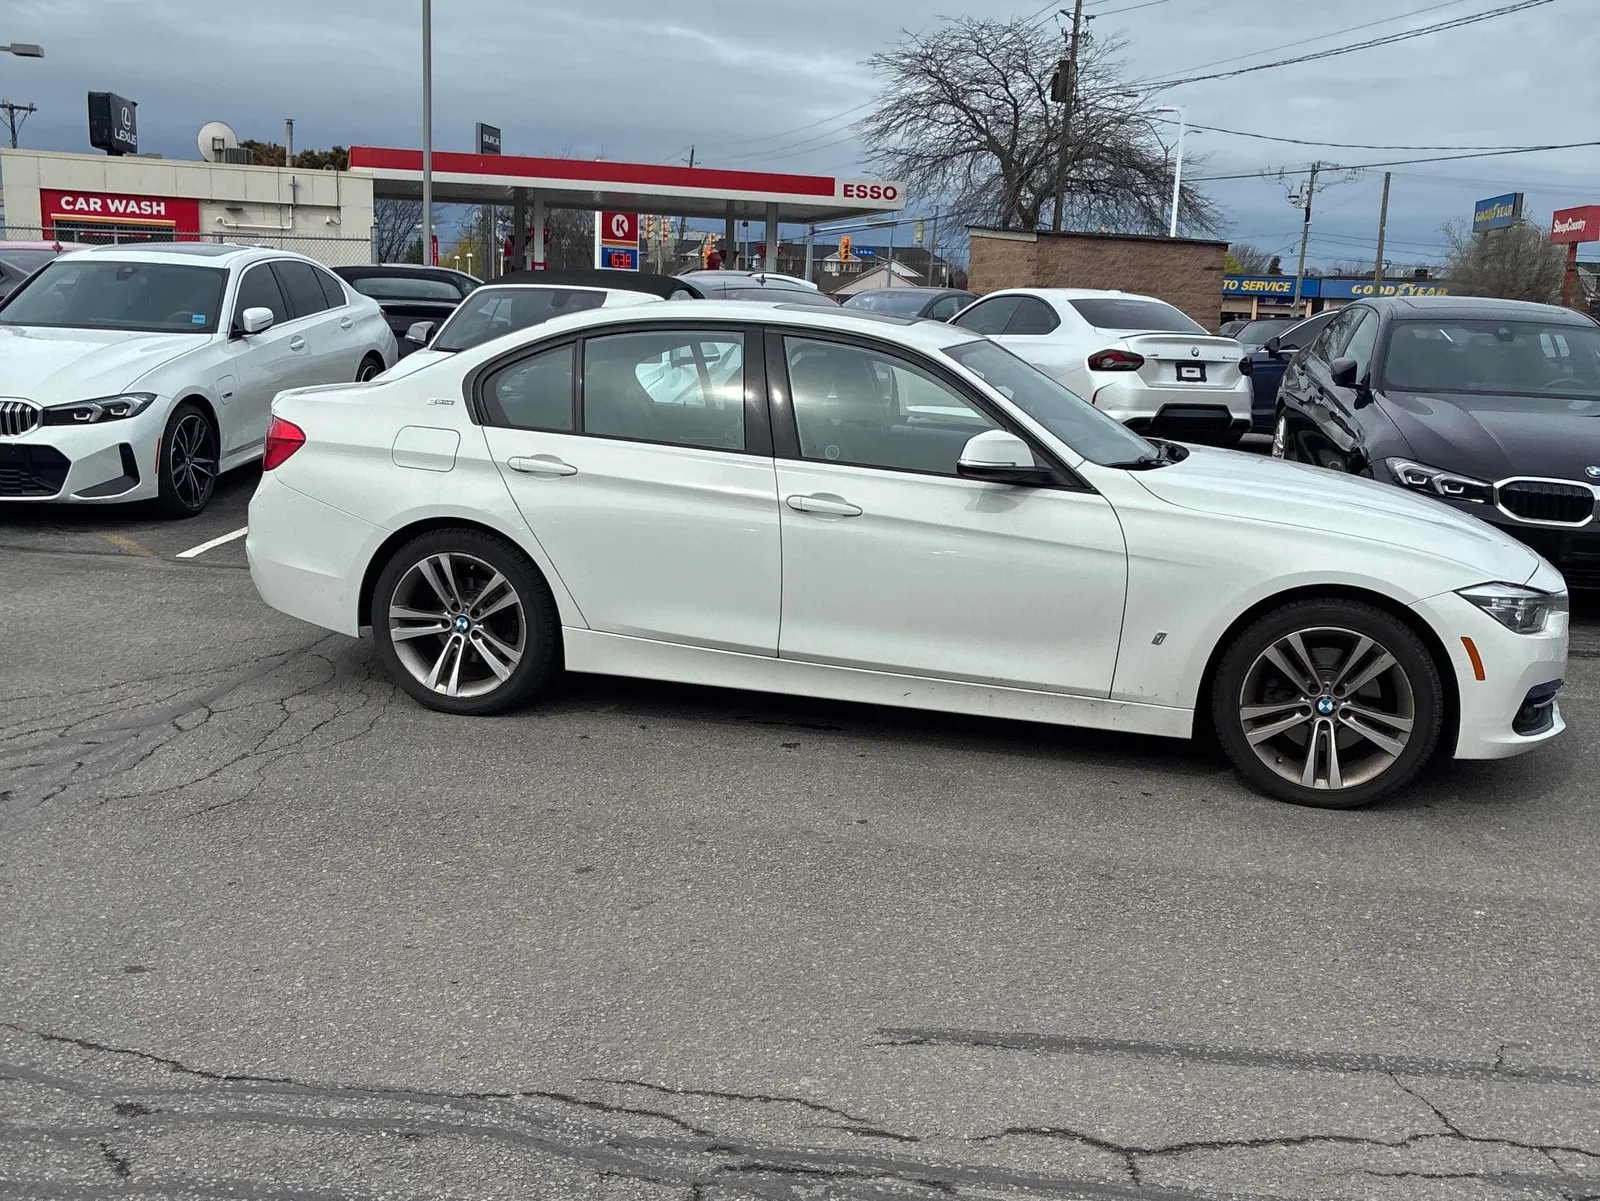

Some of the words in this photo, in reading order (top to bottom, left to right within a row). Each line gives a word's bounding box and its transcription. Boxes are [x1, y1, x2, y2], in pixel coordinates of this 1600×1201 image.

[114, 128, 137, 146] LEXUS
[483, 133, 500, 146] BUICK
[843, 184, 898, 201] ESSO
[60, 196, 102, 212] CAR
[106, 199, 166, 216] WASH
[1241, 280, 1292, 292] SERVICE
